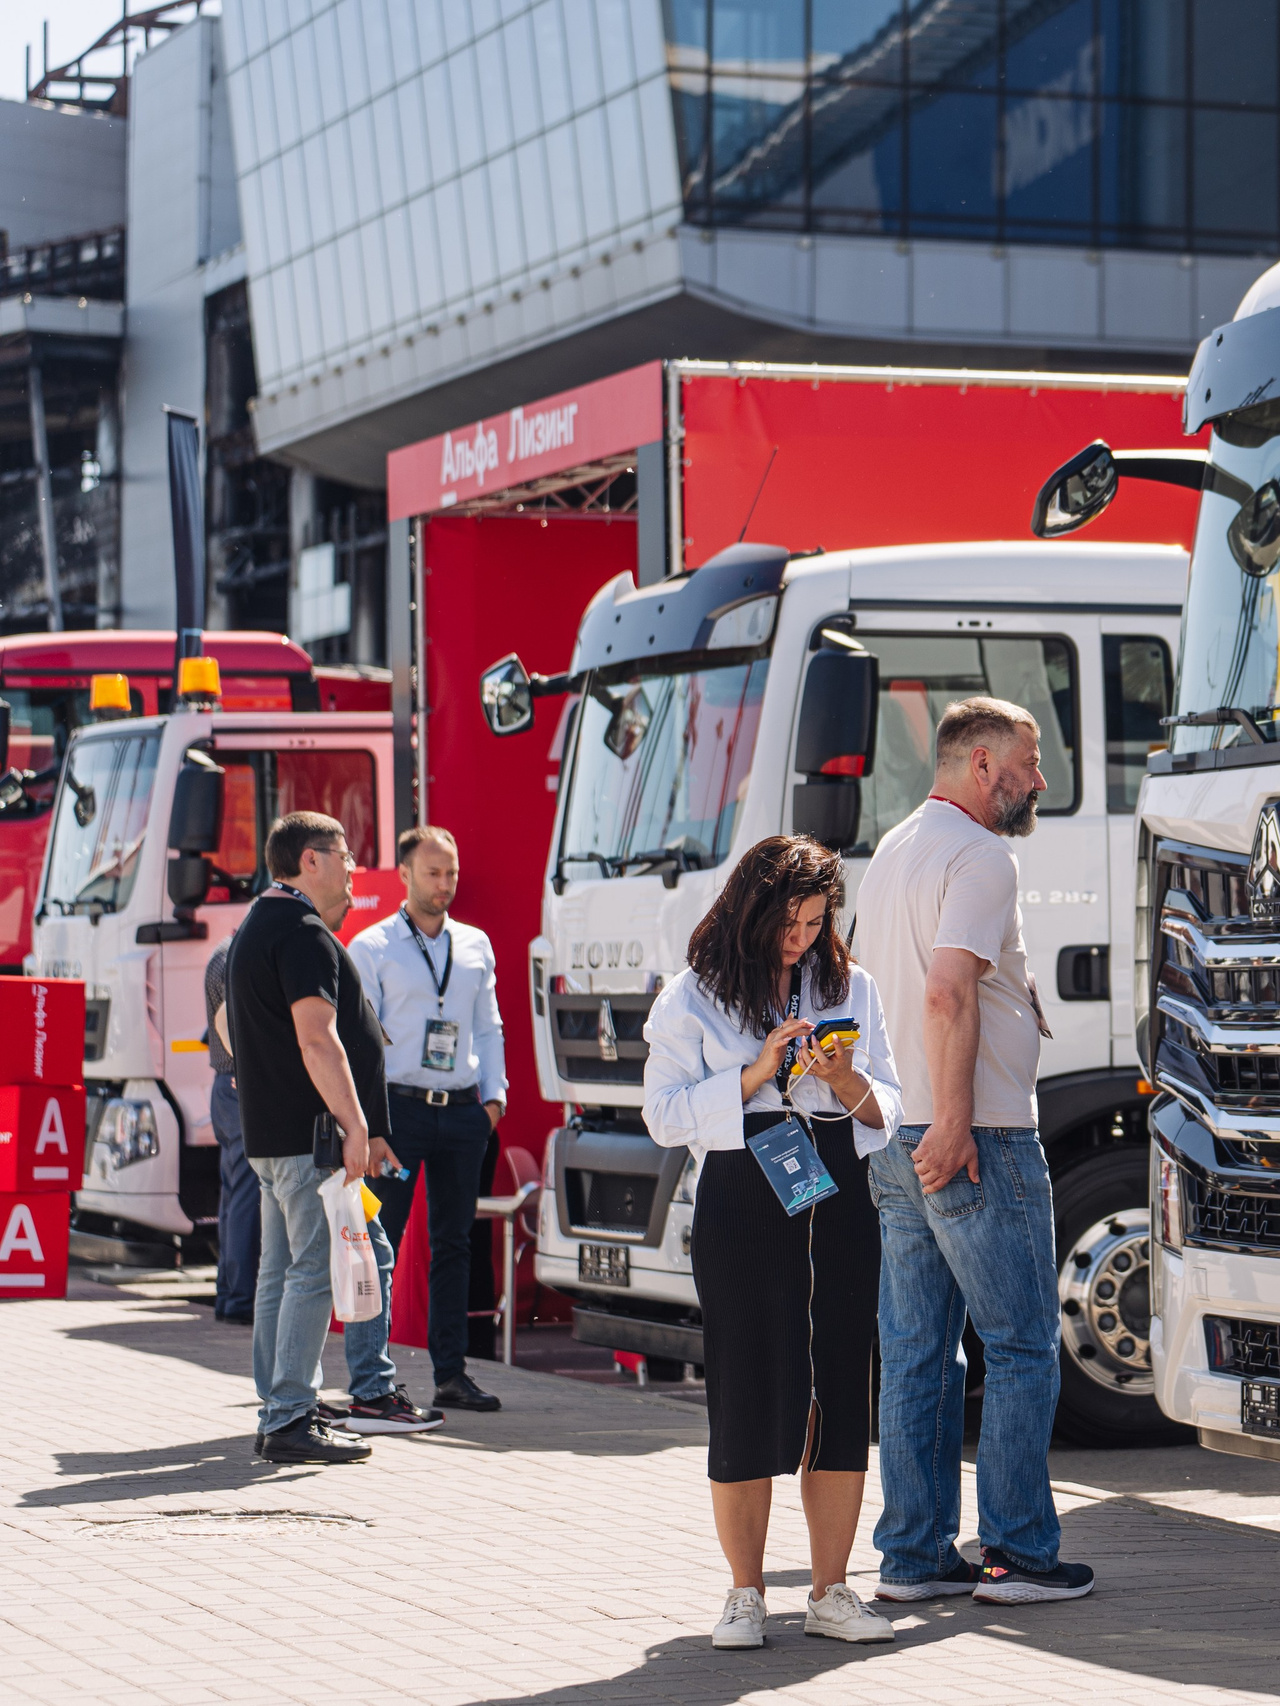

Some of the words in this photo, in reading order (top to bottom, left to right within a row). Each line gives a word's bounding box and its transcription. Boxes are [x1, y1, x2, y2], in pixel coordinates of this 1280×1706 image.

[441, 420, 498, 486] Альфа
[507, 402, 578, 463] Лизинг
[1049, 889, 1098, 904] 280
[571, 941, 644, 969] HOWO
